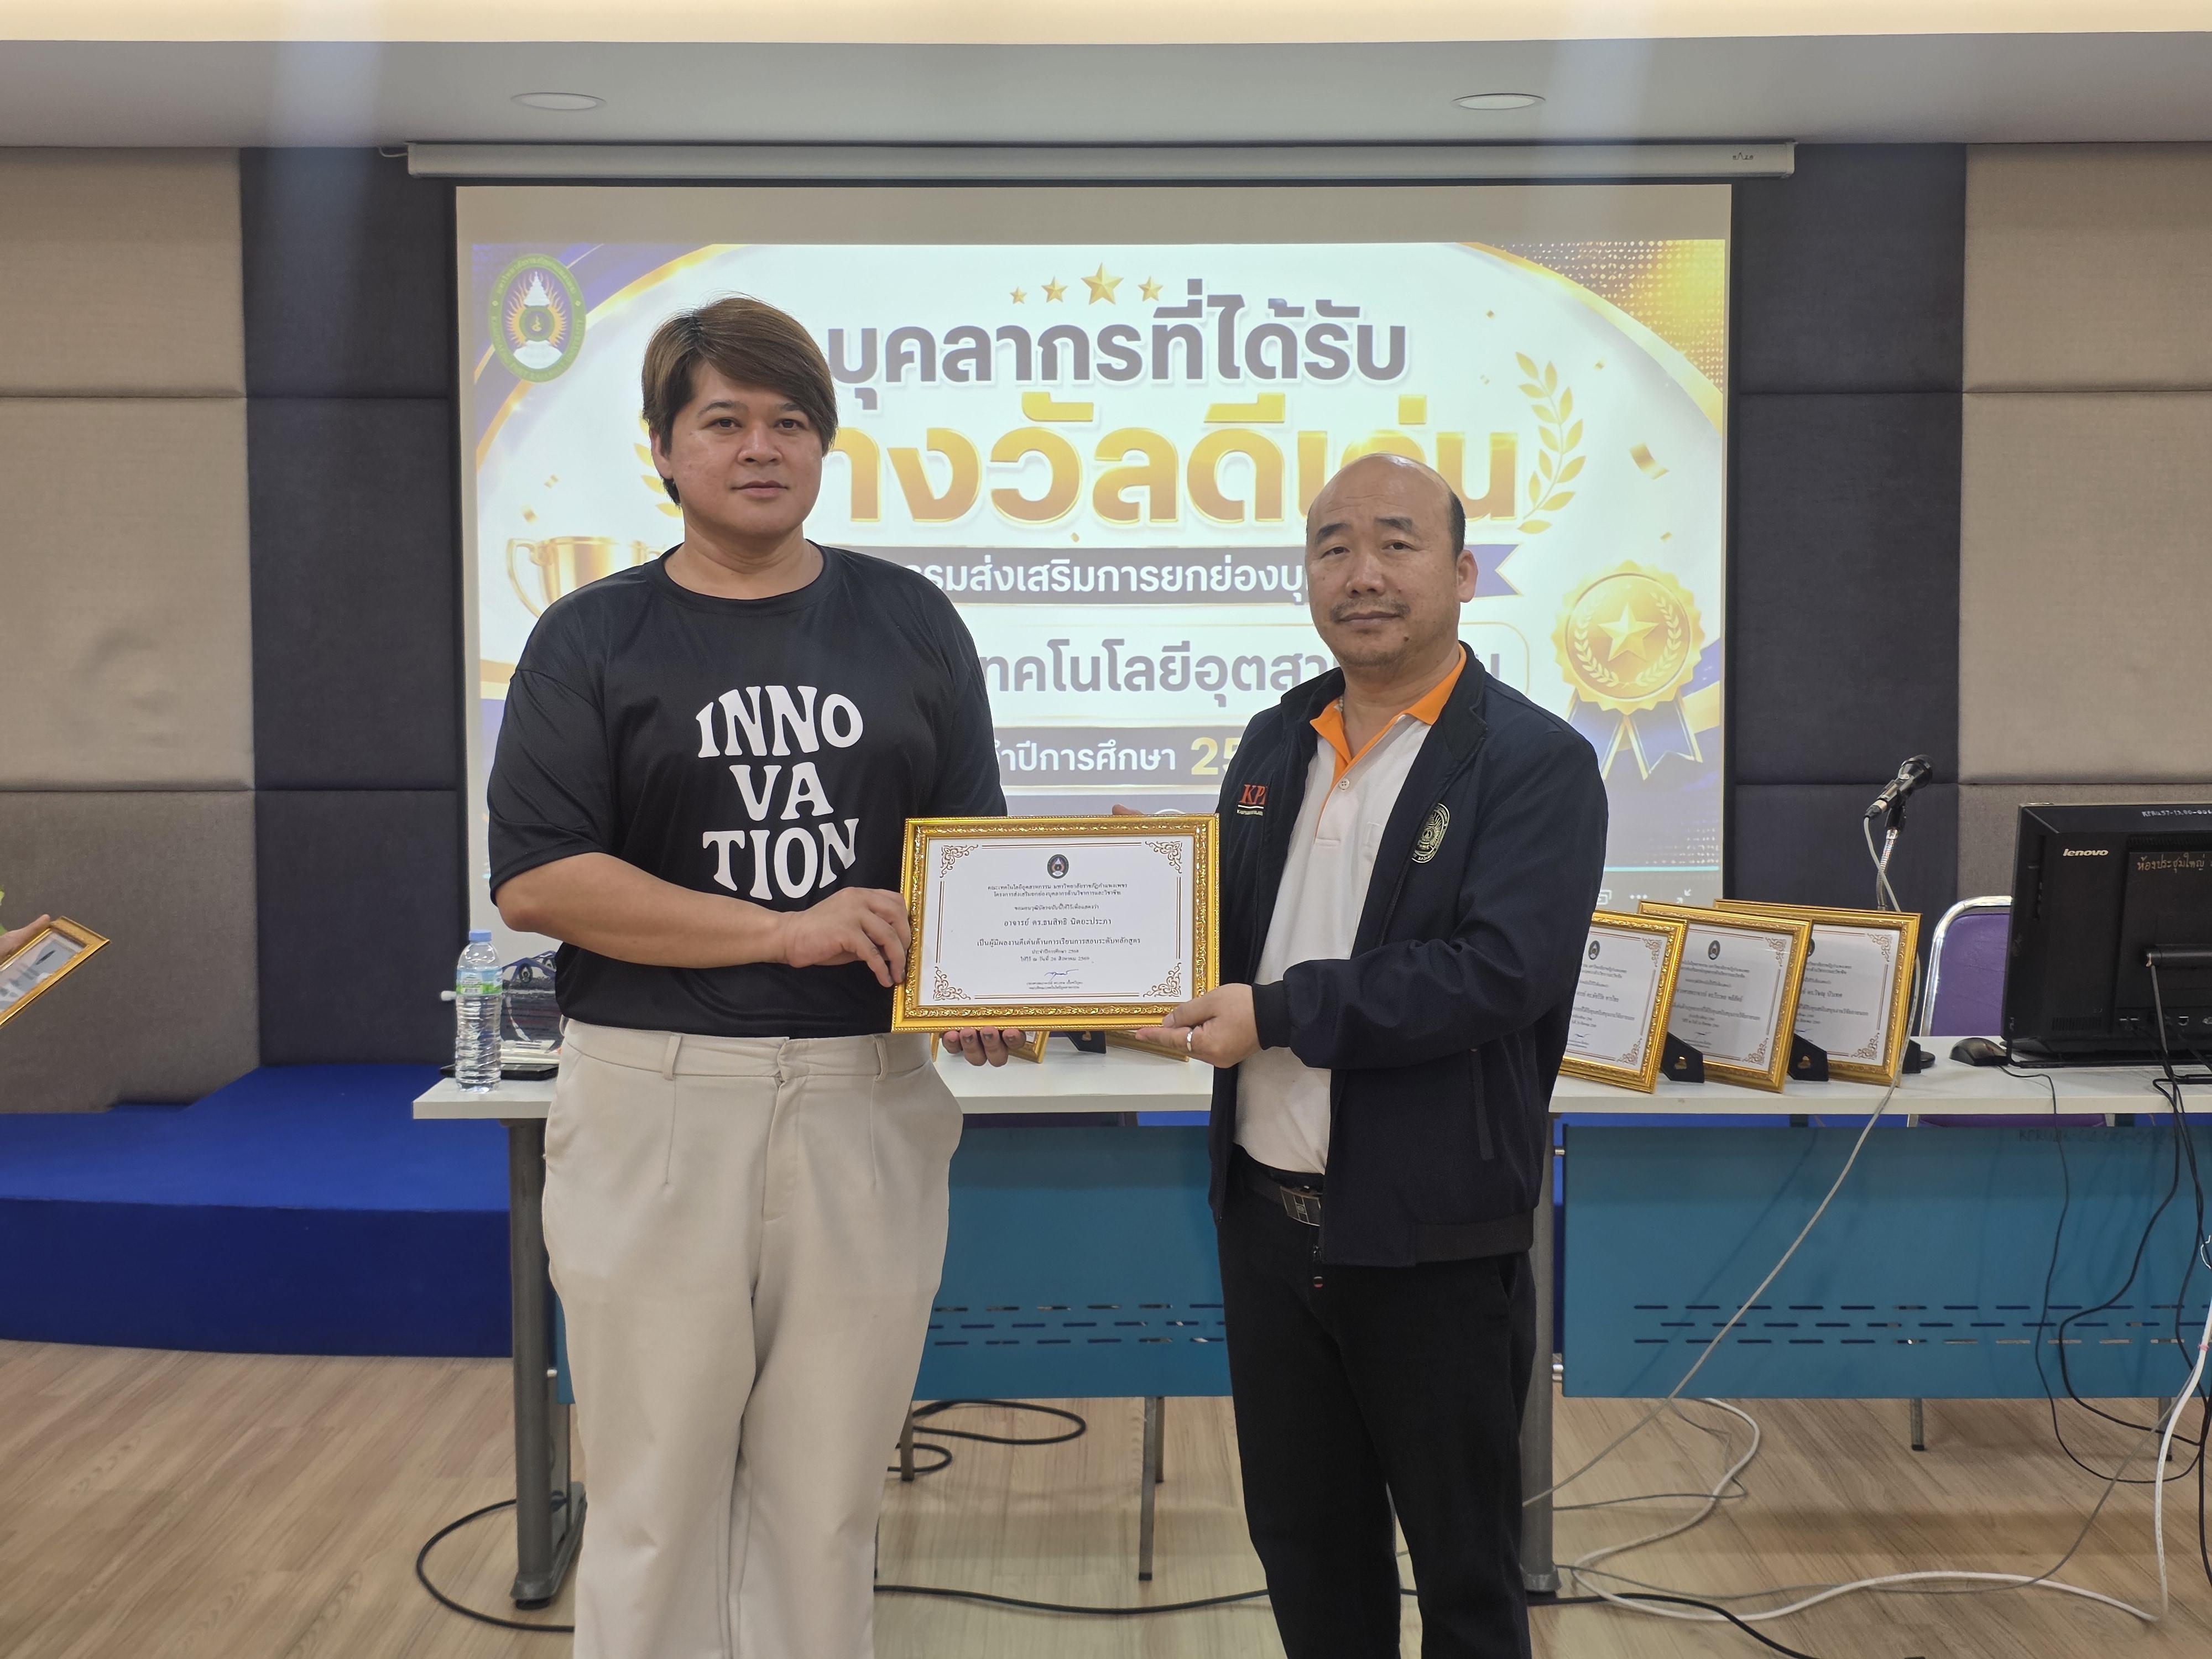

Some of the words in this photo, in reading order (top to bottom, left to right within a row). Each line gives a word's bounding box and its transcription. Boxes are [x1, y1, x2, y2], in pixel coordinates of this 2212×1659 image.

[828, 278, 1406, 411] บุคลากรที่ได้รับ
[905, 554, 1303, 602] รมส่งเสริมการยกย่องบุ
[696, 685, 863, 758] INNO
[995, 738, 1176, 772] ำปีการศึกษา
[729, 761, 834, 821] VA
[702, 818, 859, 900] TION
[2063, 848, 2109, 857] lenovo
[2137, 852, 2205, 874] ห้องประชุมใหญ่
[1004, 917, 1030, 927] อาจารย์
